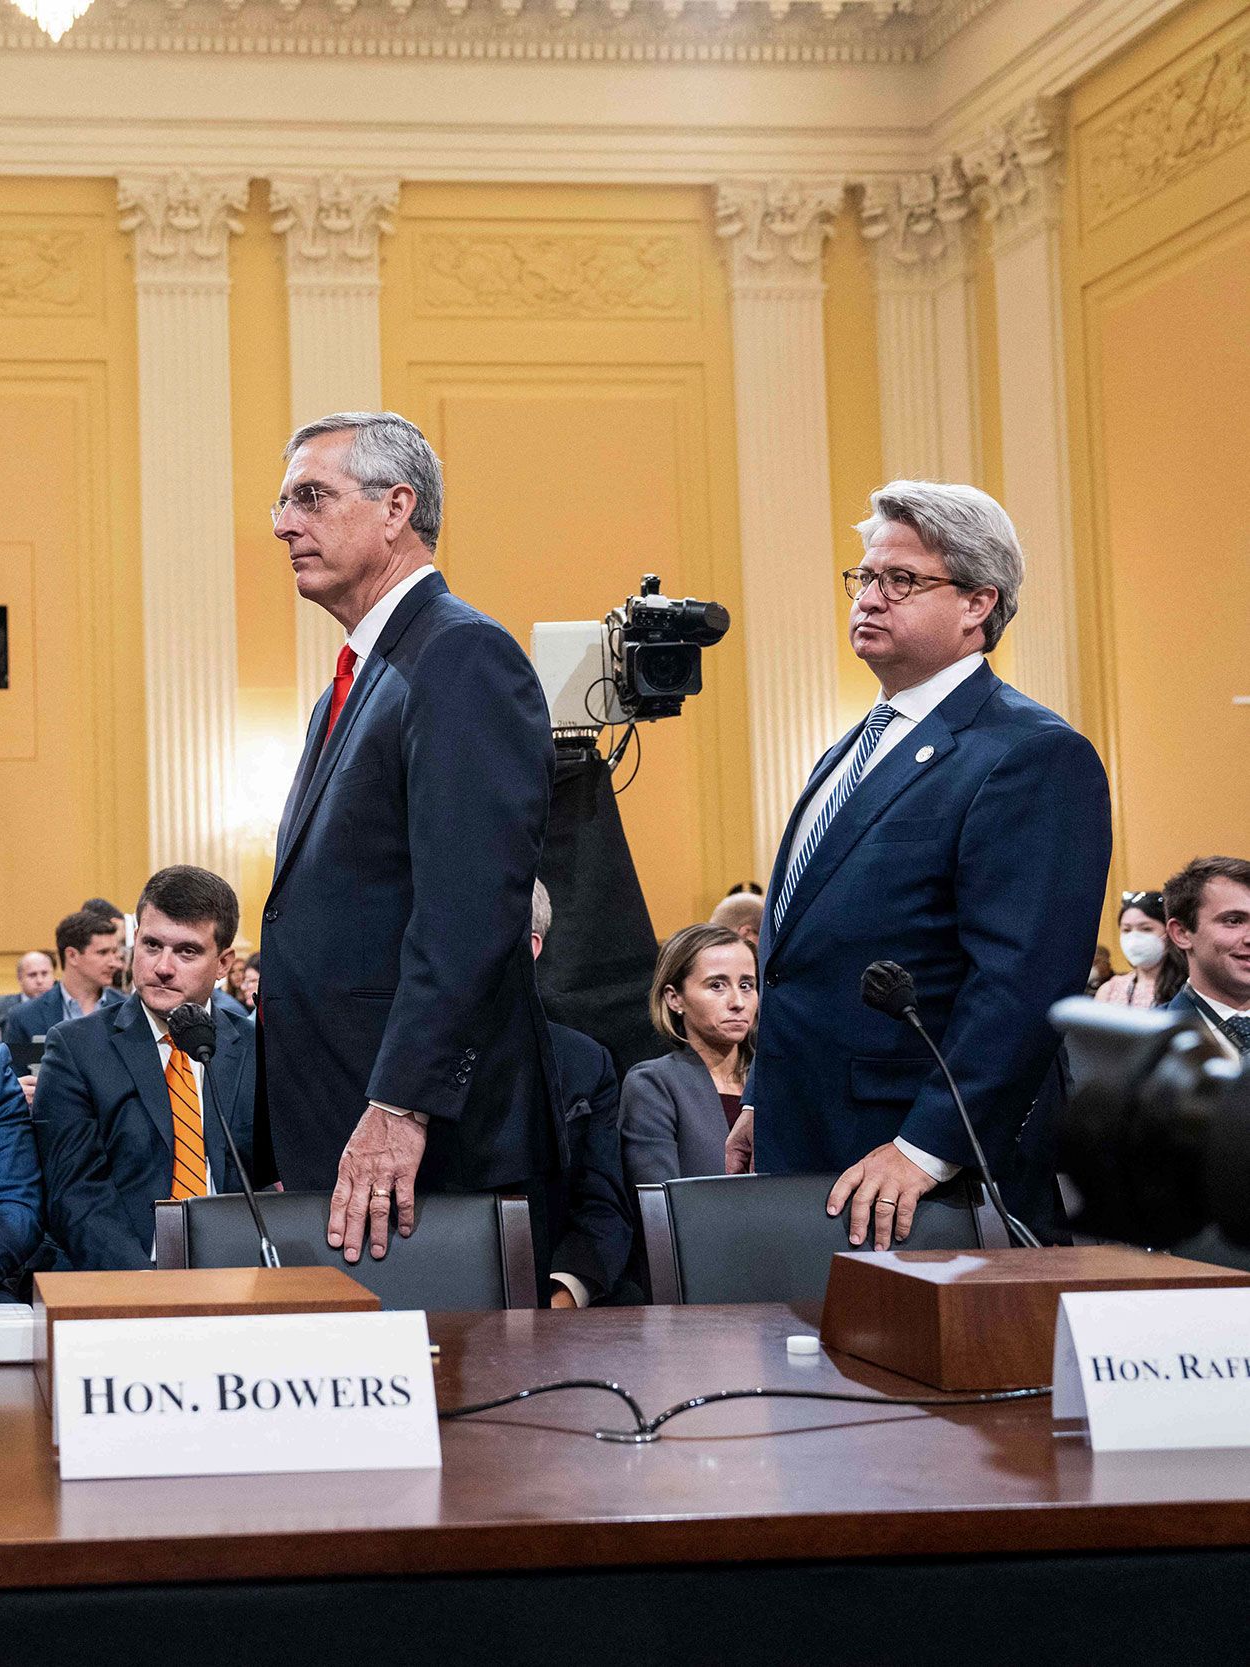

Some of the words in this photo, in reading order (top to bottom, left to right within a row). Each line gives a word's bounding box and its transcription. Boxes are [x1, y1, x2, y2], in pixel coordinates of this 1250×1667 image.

[1090, 1354, 1170, 1382] HON.
[80, 1375, 199, 1415] HON.
[214, 1373, 412, 1411] BOWERS
